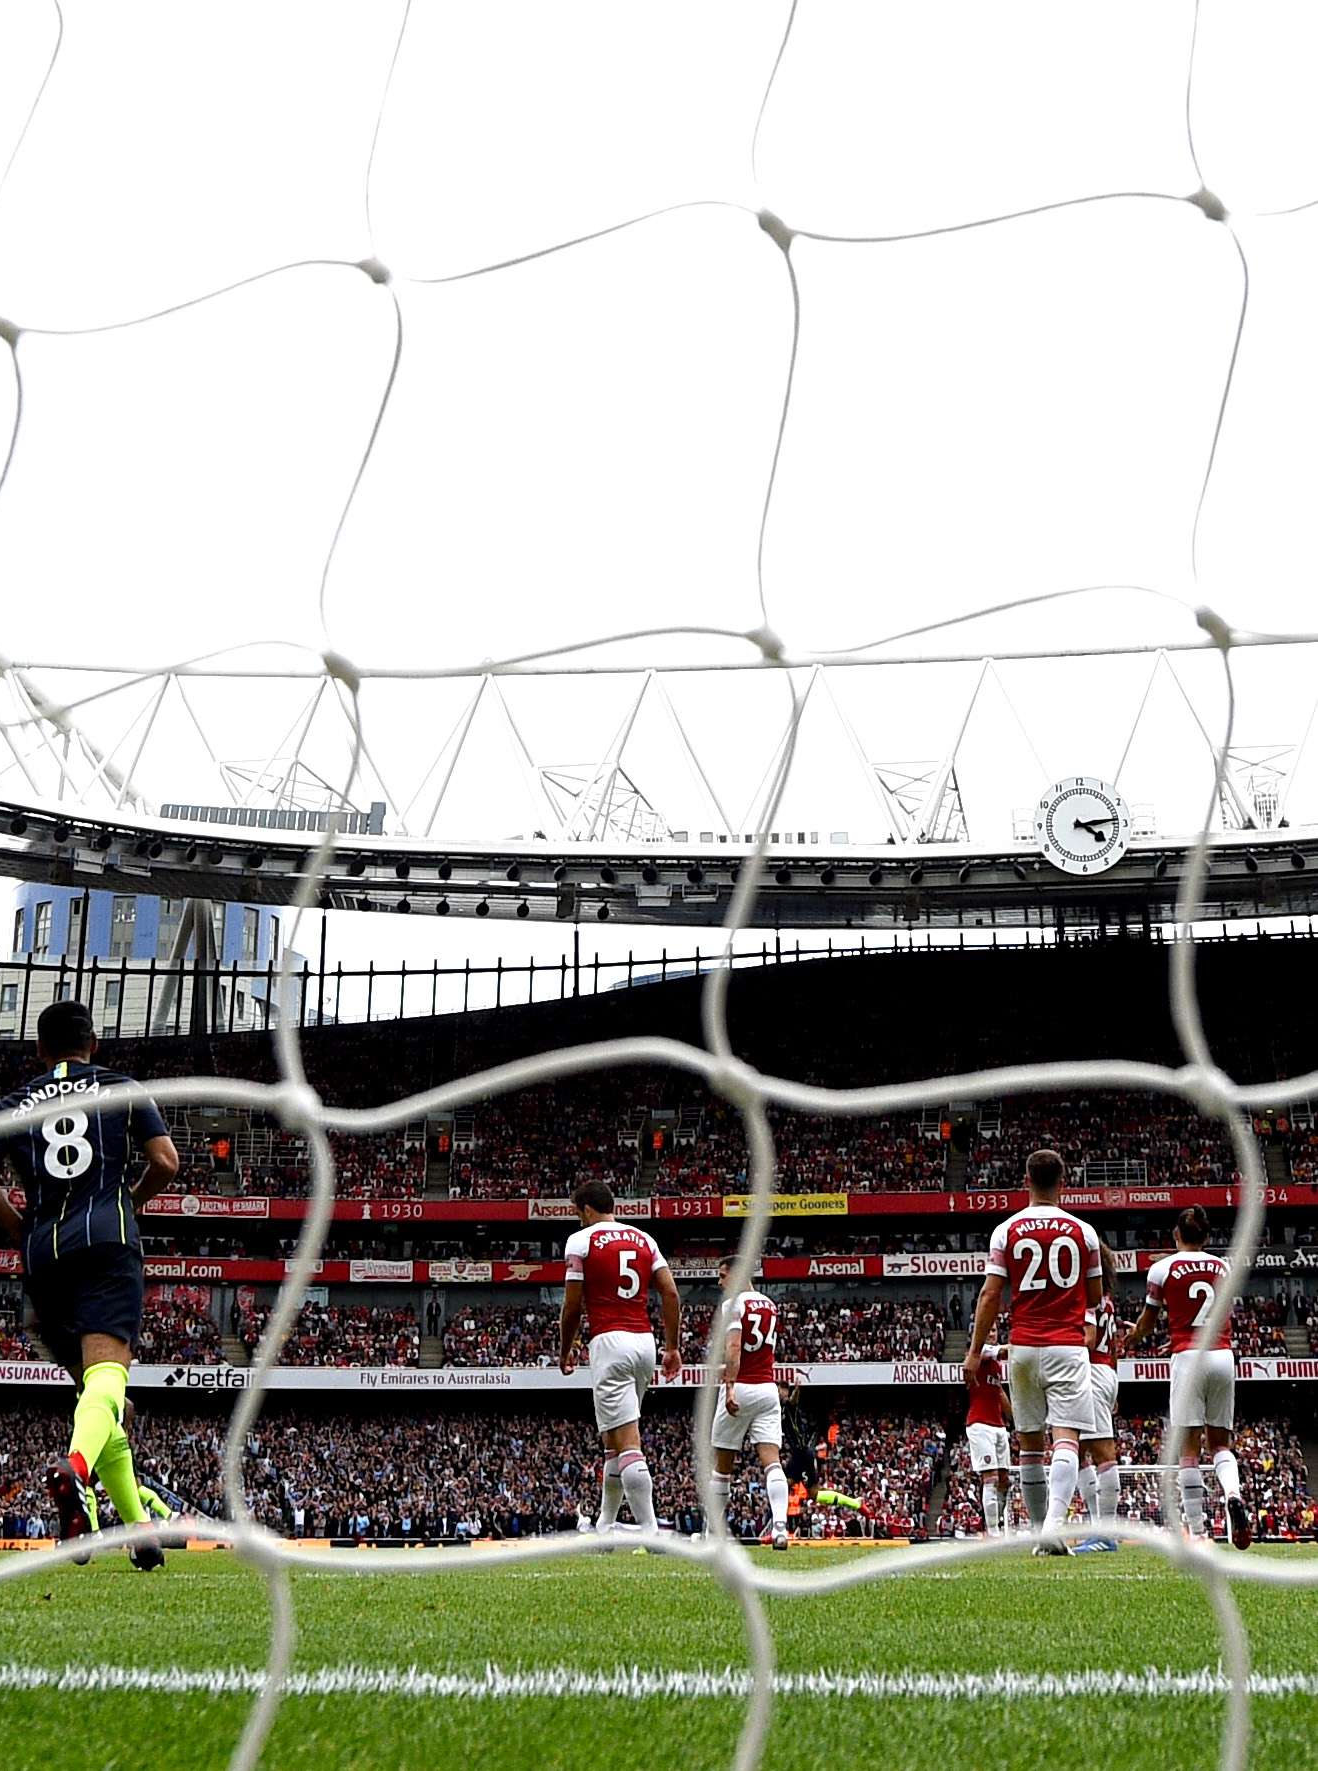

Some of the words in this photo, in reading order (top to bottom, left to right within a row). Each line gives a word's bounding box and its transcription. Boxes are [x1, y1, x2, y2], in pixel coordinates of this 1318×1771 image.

[1055, 784, 1062, 792] 11
[1075, 778, 1084, 786] 12
[1040, 801, 1049, 809] 10
[1116, 798, 1121, 806] 2
[1037, 822, 1043, 830] 9
[1123, 819, 1128, 827] 3
[1044, 844, 1050, 852] 8
[1060, 859, 1066, 867] 7
[1104, 858, 1110, 866] 5
[42, 1109, 93, 1179] 8
[1061, 1194, 1101, 1204] FAITHFUL
[1129, 1193, 1170, 1203] FOREVER
[1257, 1188, 1288, 1203] 934
[201, 1202, 230, 1213] ARSENAL
[233, 1201, 266, 1212] DENMARK
[531, 1203, 575, 1216] Arsena
[615, 1200, 649, 1216] nesia
[672, 1201, 713, 1216] 1931
[799, 1199, 845, 1210] Gooners
[966, 1196, 1008, 1210] 1933
[381, 1204, 423, 1218] 1930
[1016, 1218, 1073, 1236] MUSTAFI
[594, 1231, 645, 1249] SOKRATIS
[142, 1261, 222, 1279] rsenal.com
[808, 1258, 864, 1276] Arsenal
[910, 1256, 985, 1274] Slovenia
[1013, 1235, 1080, 1292] 20
[617, 1250, 640, 1299] 5
[1188, 1281, 1216, 1327] 2
[743, 1313, 778, 1354] 34
[1134, 1363, 1170, 1380] PUM
[360, 1373, 377, 1387] Fly
[381, 1373, 429, 1385] Emirates
[433, 1374, 444, 1385] to
[448, 1373, 511, 1385] Australasia
